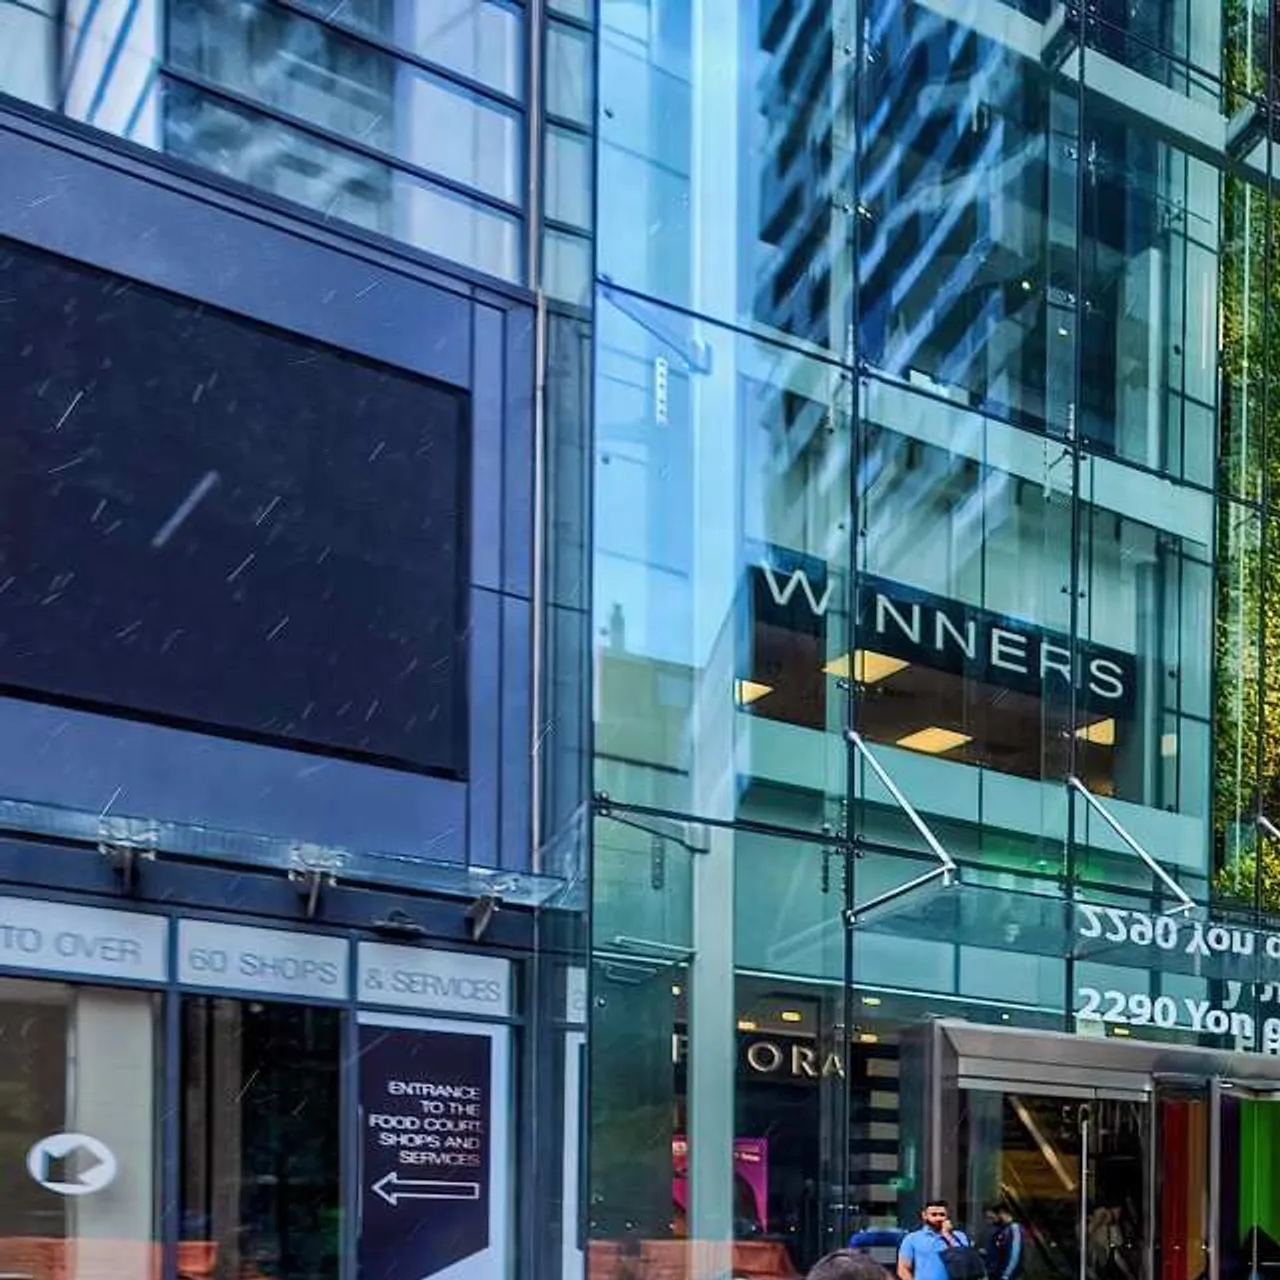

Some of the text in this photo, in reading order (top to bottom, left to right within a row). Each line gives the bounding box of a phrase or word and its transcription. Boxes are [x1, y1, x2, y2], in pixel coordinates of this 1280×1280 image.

[2, 923, 142, 966] TO OVER
[189, 946, 338, 986] 60 SHOPS
[364, 967, 501, 1002] & SERVICES
[1075, 987, 1177, 1028] 2290
[672, 1032, 846, 1078] PORA
[388, 1081, 481, 1100] ENTRANCE
[368, 1113, 420, 1130] FOOD
[420, 1099, 481, 1117] TO THE
[379, 1131, 480, 1150] SHOPS AND
[399, 1149, 481, 1168] SERVICES
